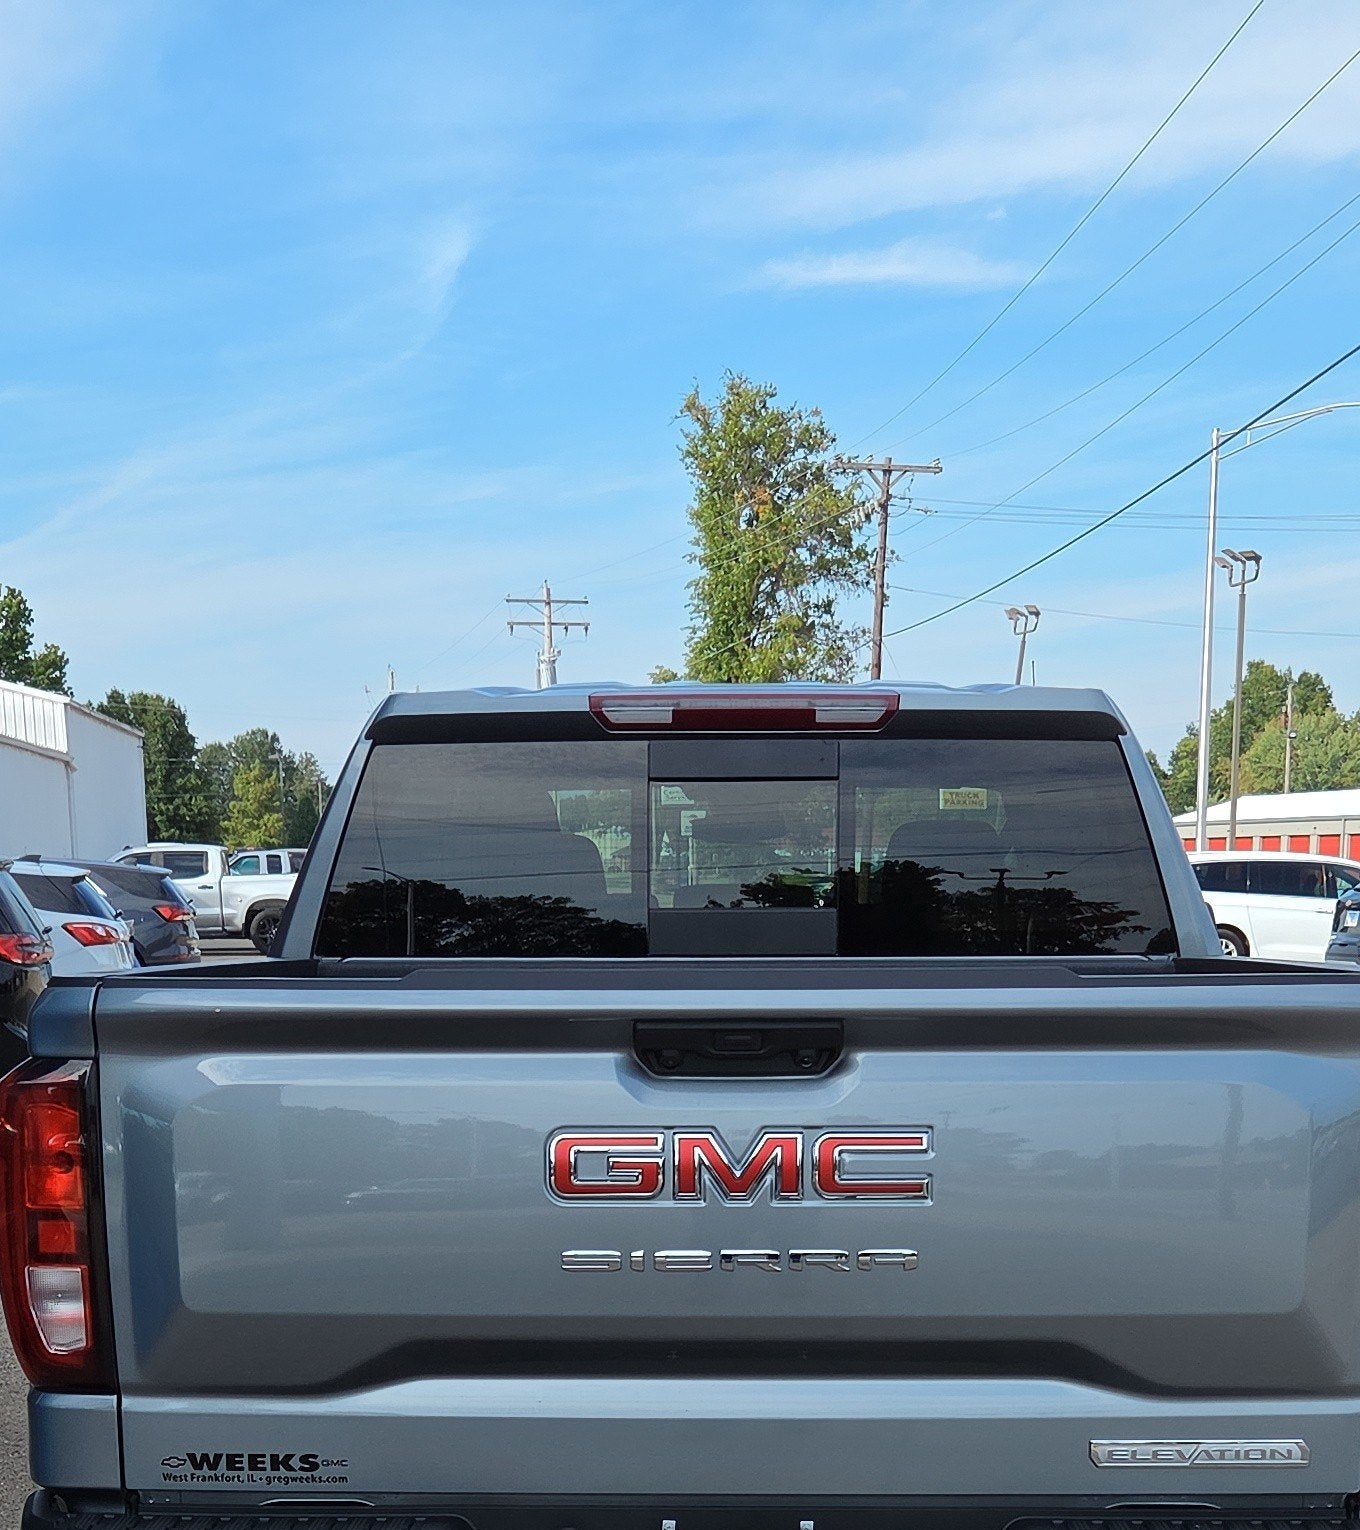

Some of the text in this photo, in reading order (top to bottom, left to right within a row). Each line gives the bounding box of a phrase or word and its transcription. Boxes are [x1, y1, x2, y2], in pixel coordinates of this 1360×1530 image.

[547, 1130, 932, 1202] GMC
[560, 1248, 920, 1273] SIERRA
[186, 1452, 349, 1472] WEEKS GMC
[1106, 1448, 1293, 1461] ELEVATION
[162, 1472, 349, 1486] West Frankfort, IL gregweeks.com
